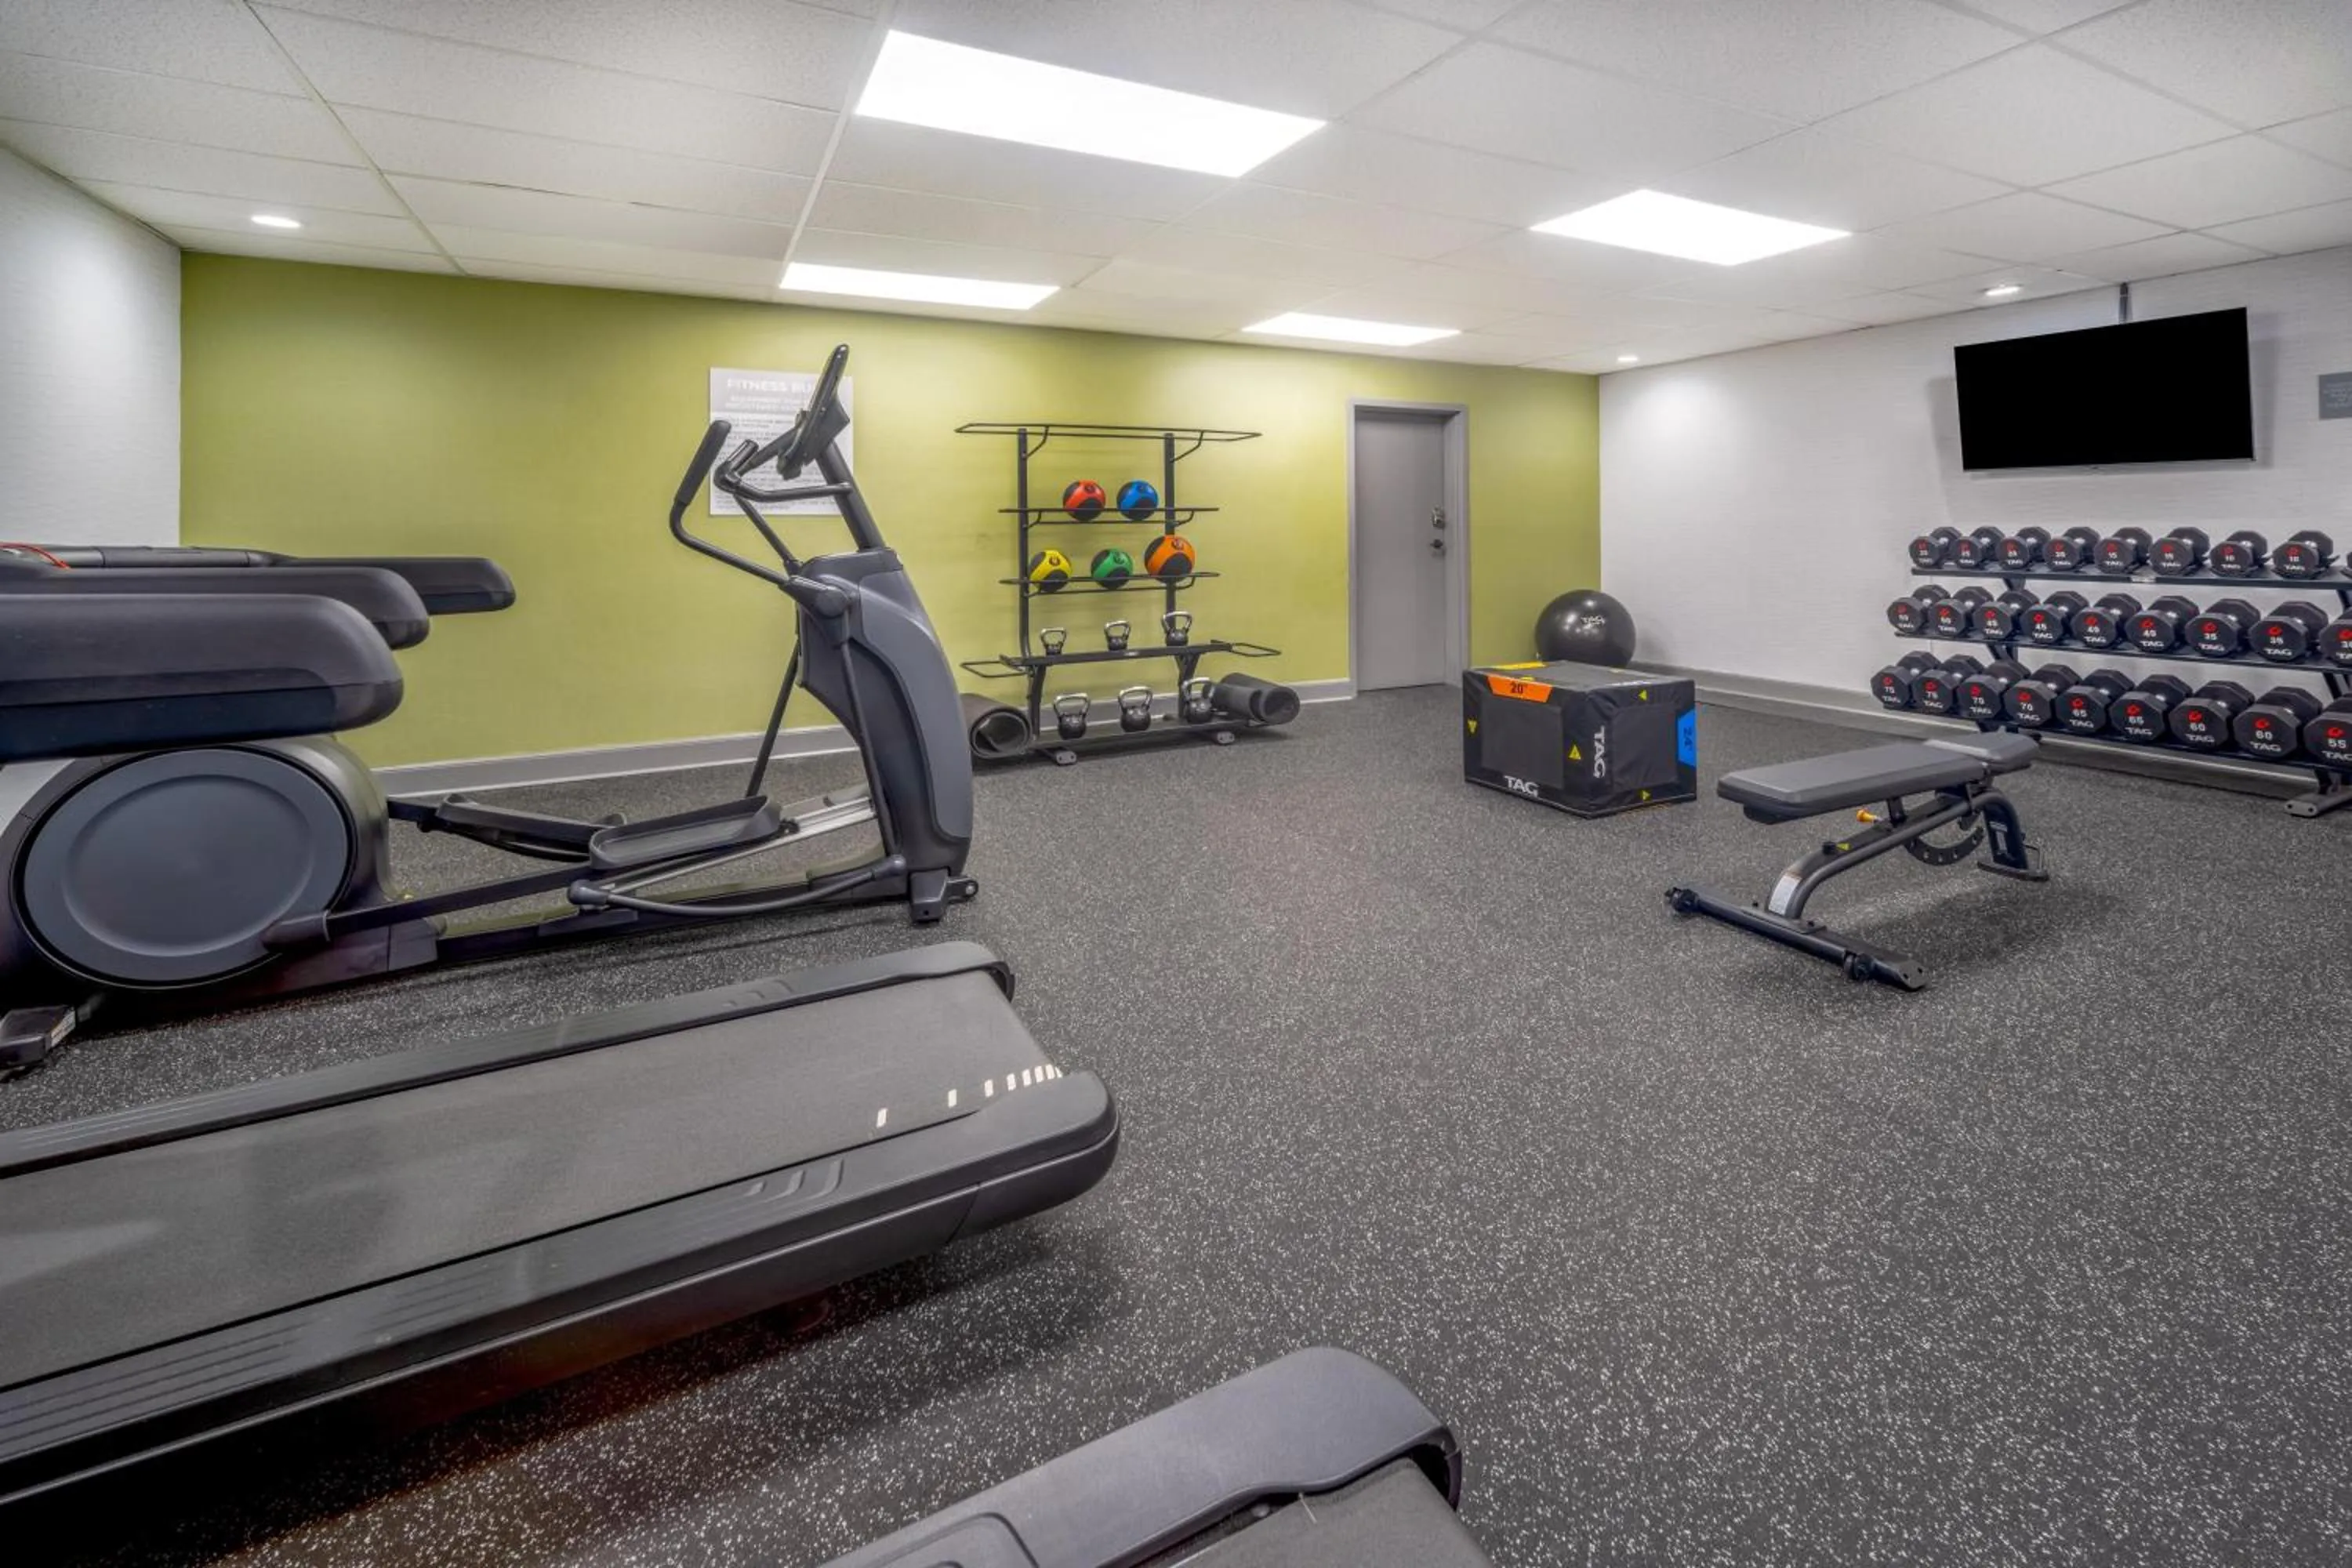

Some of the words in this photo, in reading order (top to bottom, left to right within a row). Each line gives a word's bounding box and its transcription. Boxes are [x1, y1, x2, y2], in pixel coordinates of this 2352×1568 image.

[2263, 648, 2292, 656] TAG
[1923, 700, 1944, 709] TAG
[2016, 713, 2041, 721] TAG
[2069, 718, 2095, 728] TAG
[2125, 726, 2154, 736] TAG
[2185, 733, 2215, 743] TAG
[1594, 725, 1606, 779] TAG
[2249, 741, 2281, 753] TAG
[1504, 775, 1540, 798] TAG
